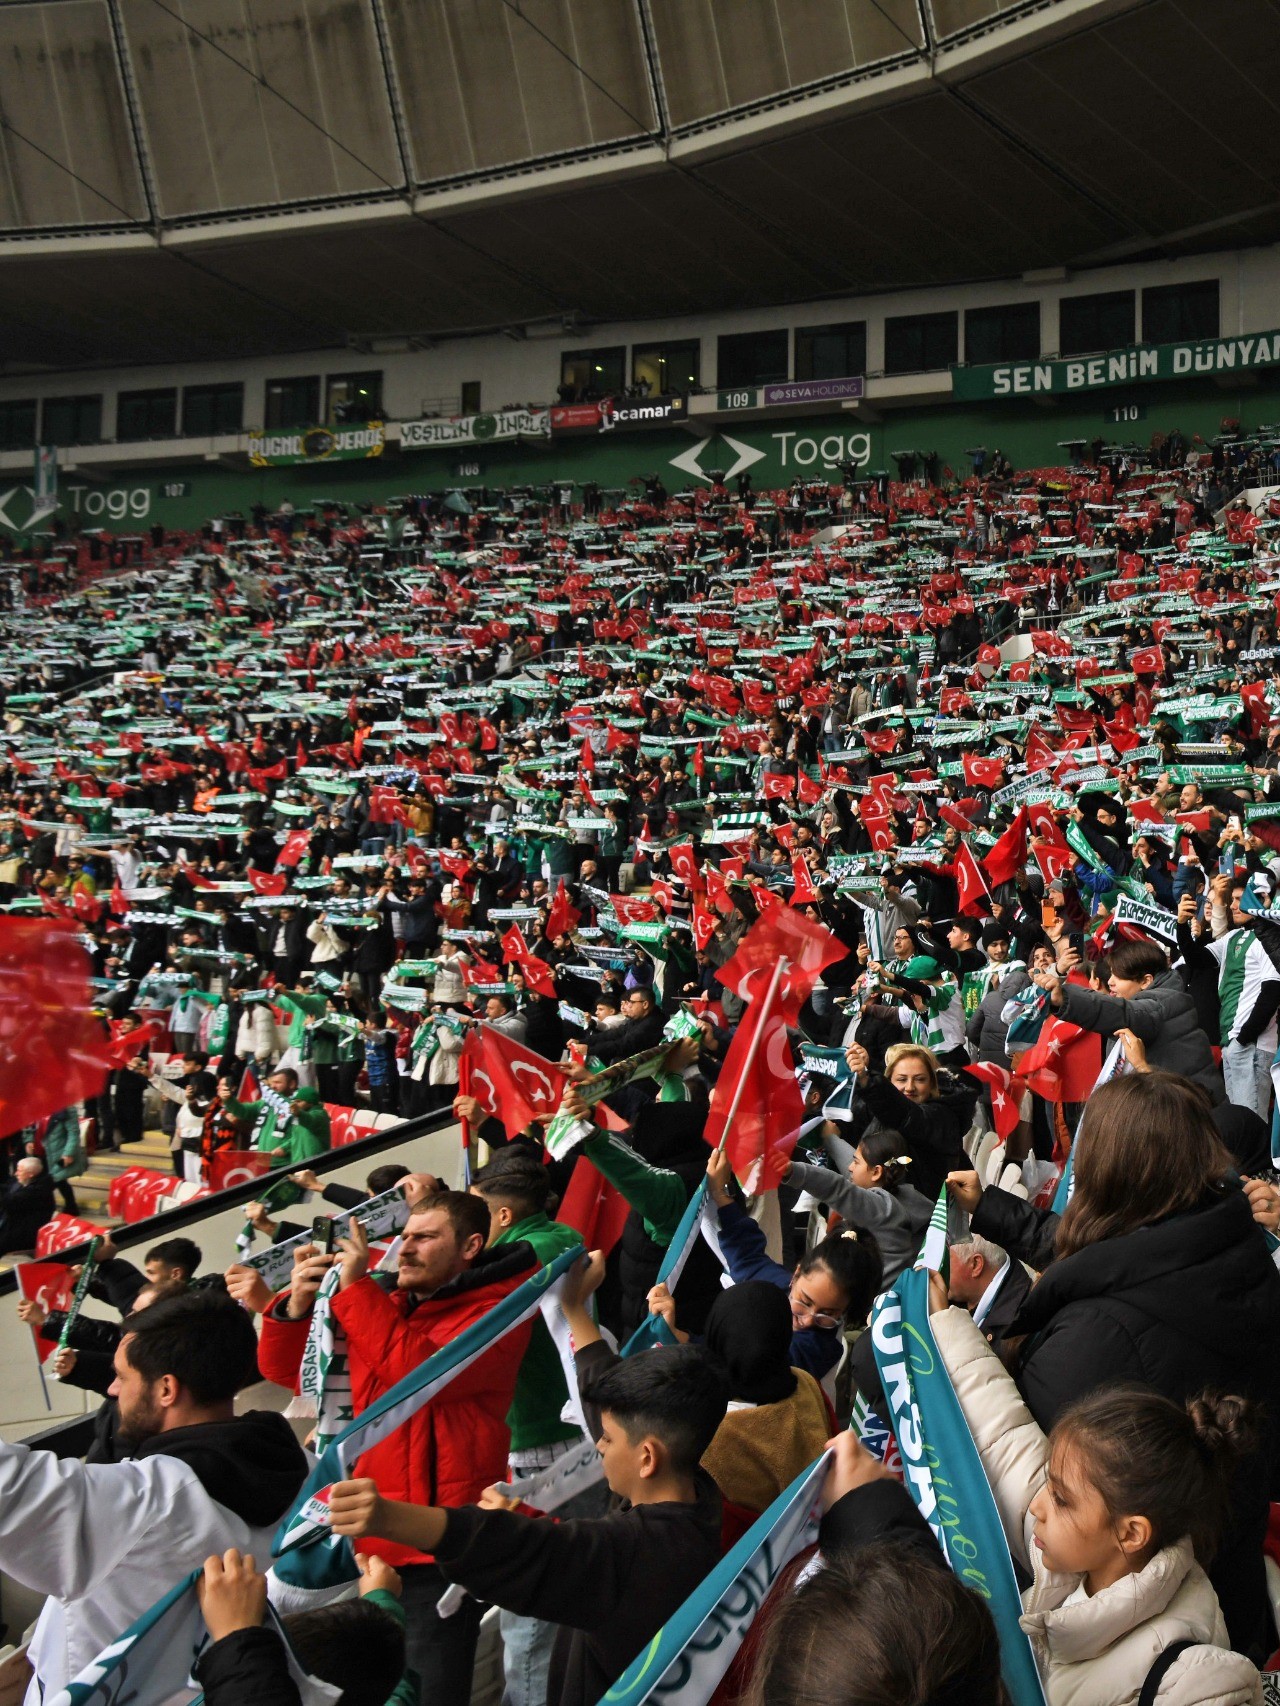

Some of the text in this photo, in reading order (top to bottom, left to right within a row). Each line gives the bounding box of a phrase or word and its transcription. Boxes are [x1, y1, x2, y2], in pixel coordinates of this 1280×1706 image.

[993, 365, 1052, 394] SEN
[1067, 350, 1158, 389] BENİM
[785, 383, 857, 399] SEVA HOLDING
[726, 392, 749, 408] 109
[1112, 405, 1138, 422] 110
[772, 432, 871, 469] Togg
[459, 463, 479, 476] 108
[165, 483, 185, 497] 107
[68, 486, 151, 519] Togg
